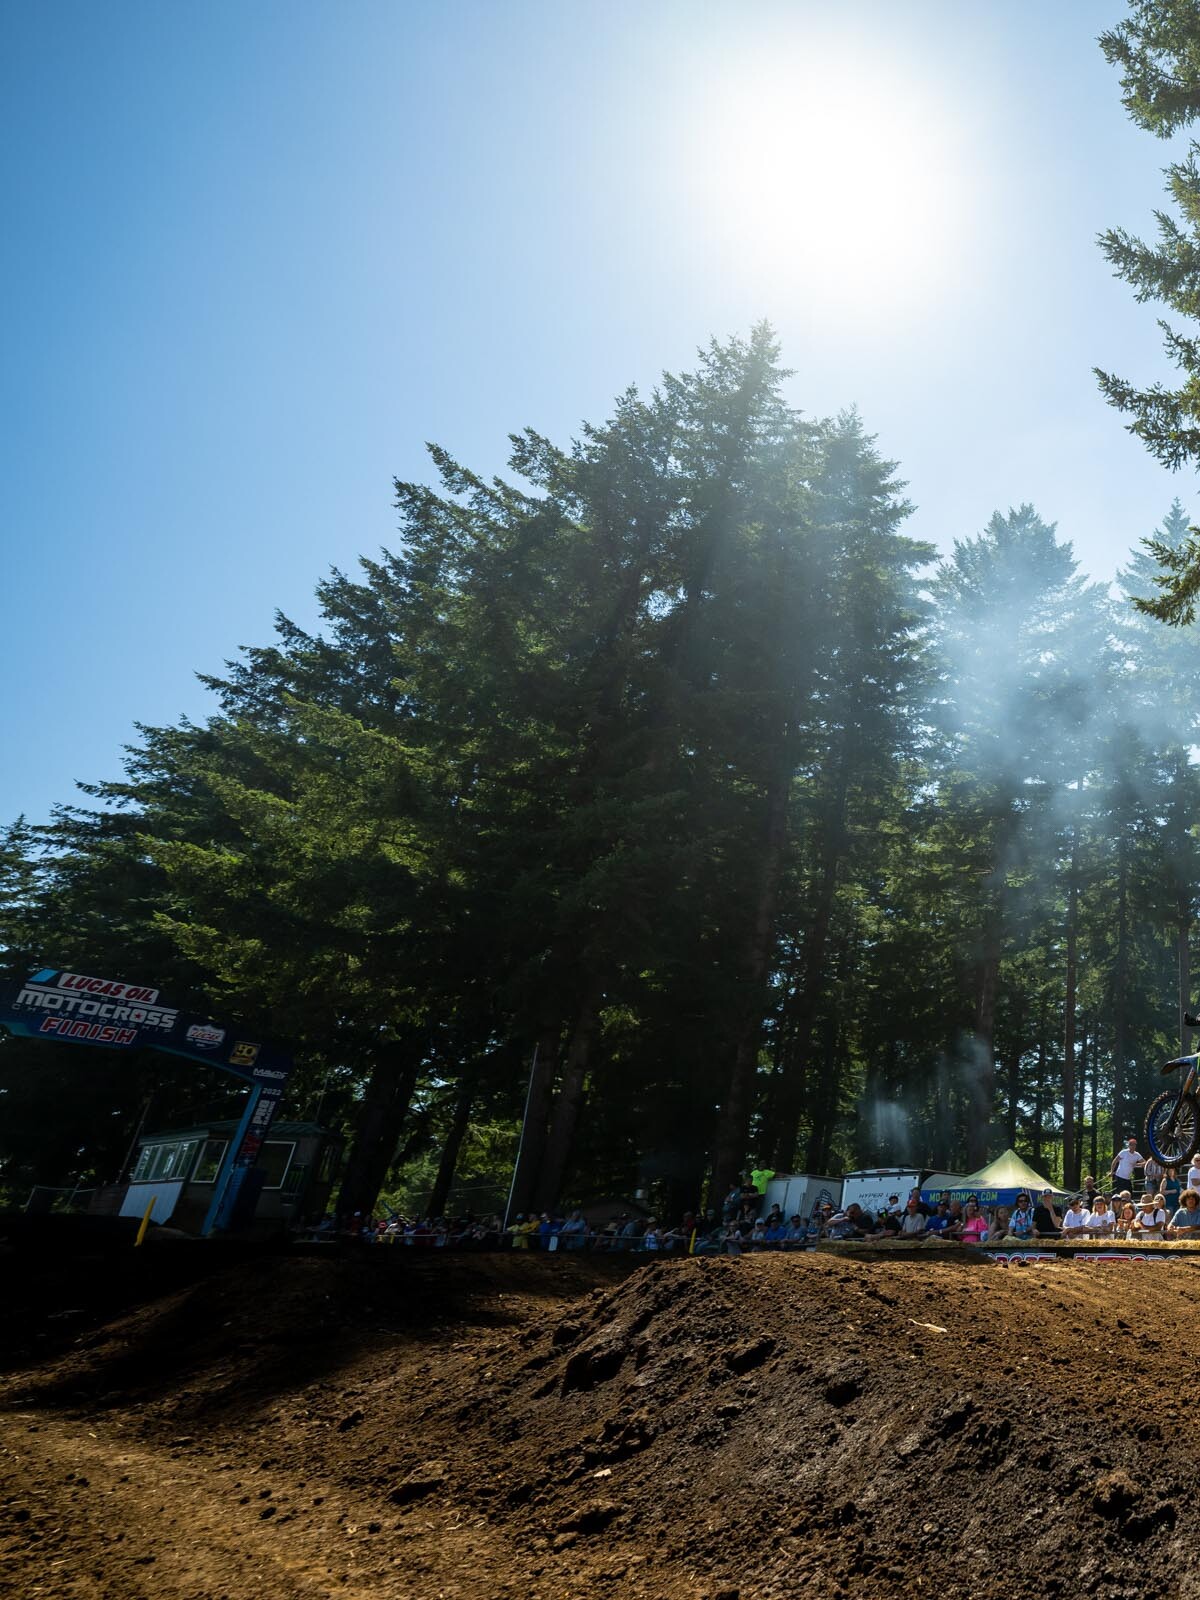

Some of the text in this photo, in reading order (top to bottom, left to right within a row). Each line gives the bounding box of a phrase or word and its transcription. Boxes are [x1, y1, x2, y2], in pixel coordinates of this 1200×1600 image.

[63, 975, 157, 1002] LUCAS OIL
[11, 1003, 171, 1033] CHAMPIONSHIP
[15, 989, 177, 1029] MOTOCROSS
[39, 1016, 138, 1045] FINISH
